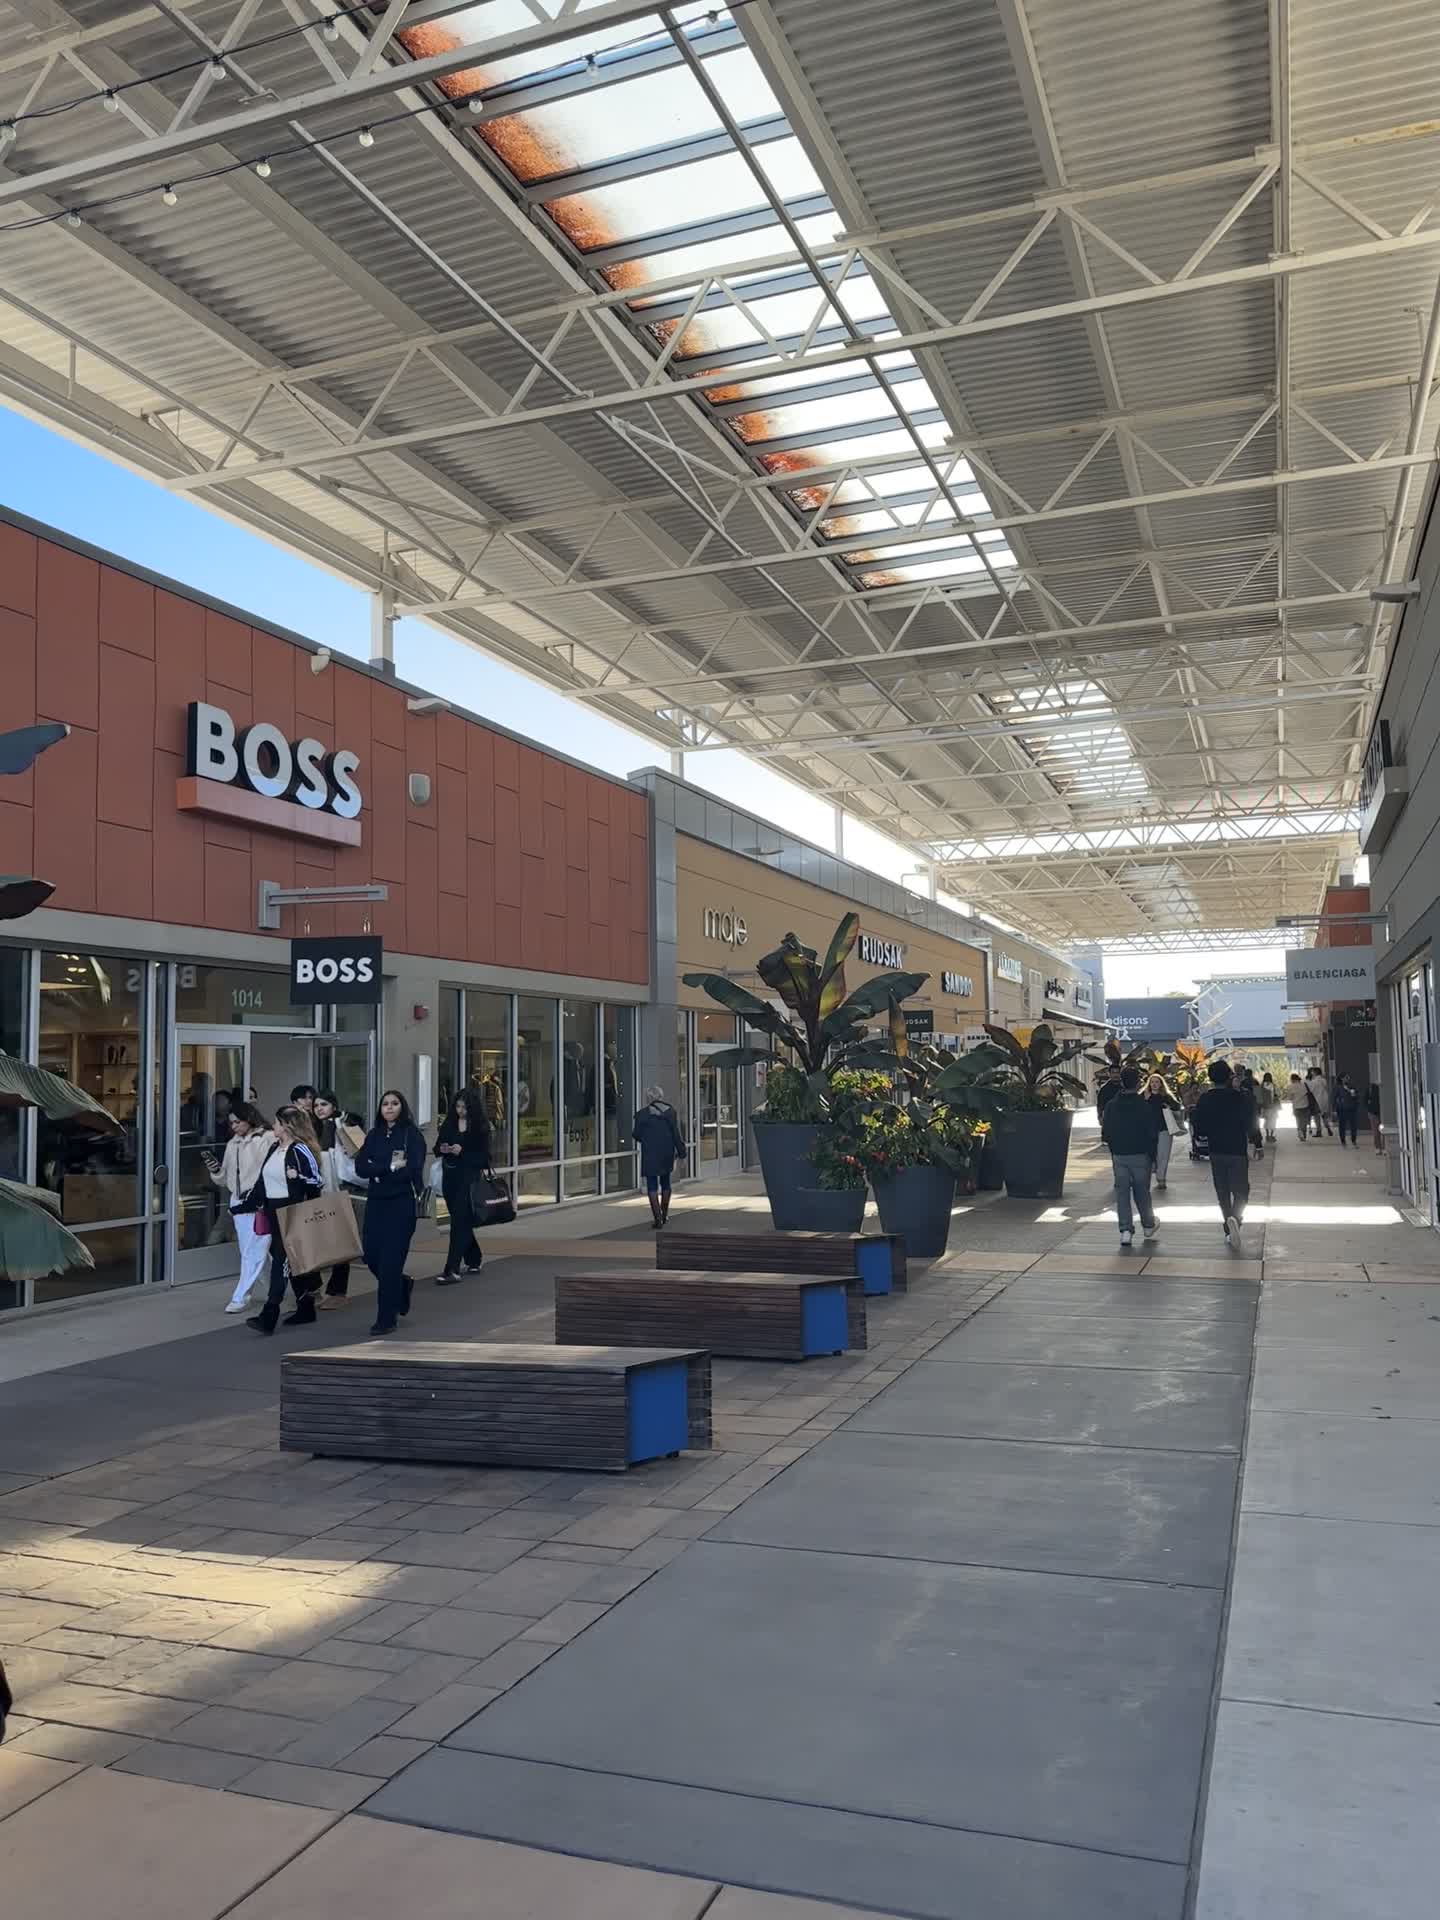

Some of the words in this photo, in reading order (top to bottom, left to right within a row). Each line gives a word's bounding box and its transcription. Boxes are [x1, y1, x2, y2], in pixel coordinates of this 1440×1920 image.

[190, 701, 362, 818] BOSS
[704, 906, 748, 952] maje
[861, 936, 903, 969] RUDSAK
[296, 957, 374, 984] BOSS
[1294, 968, 1367, 980] BALENCIAGA
[231, 989, 263, 1008] 1014
